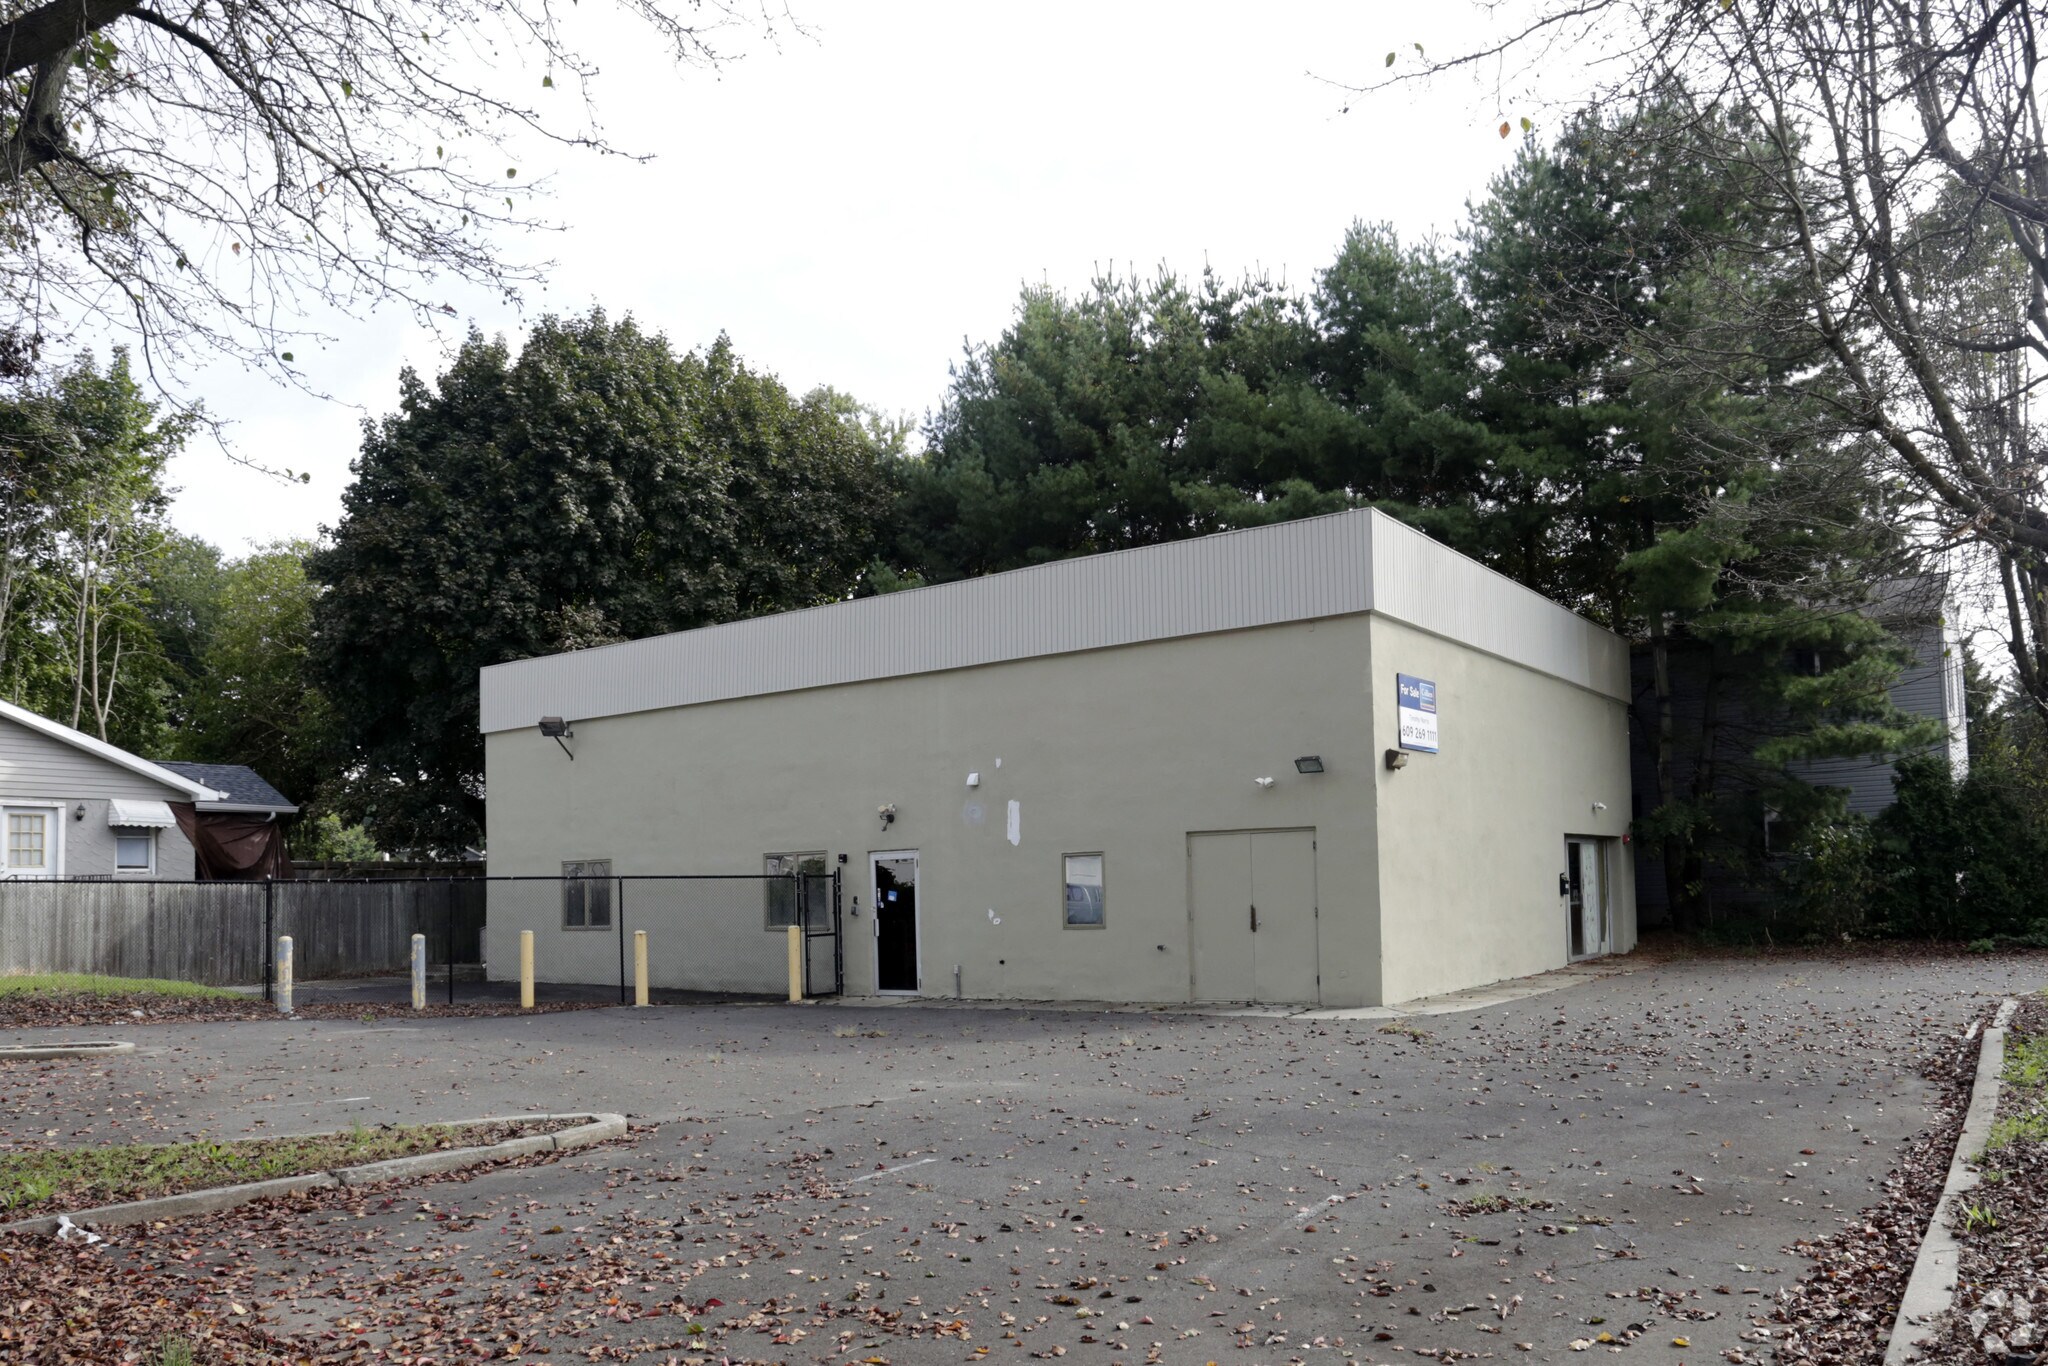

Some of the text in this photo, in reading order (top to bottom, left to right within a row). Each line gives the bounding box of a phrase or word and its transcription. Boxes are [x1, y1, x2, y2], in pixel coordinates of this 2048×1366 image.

[1400, 683, 1420, 698] For Sale
[1402, 725, 1436, 742] 609 269 1111
